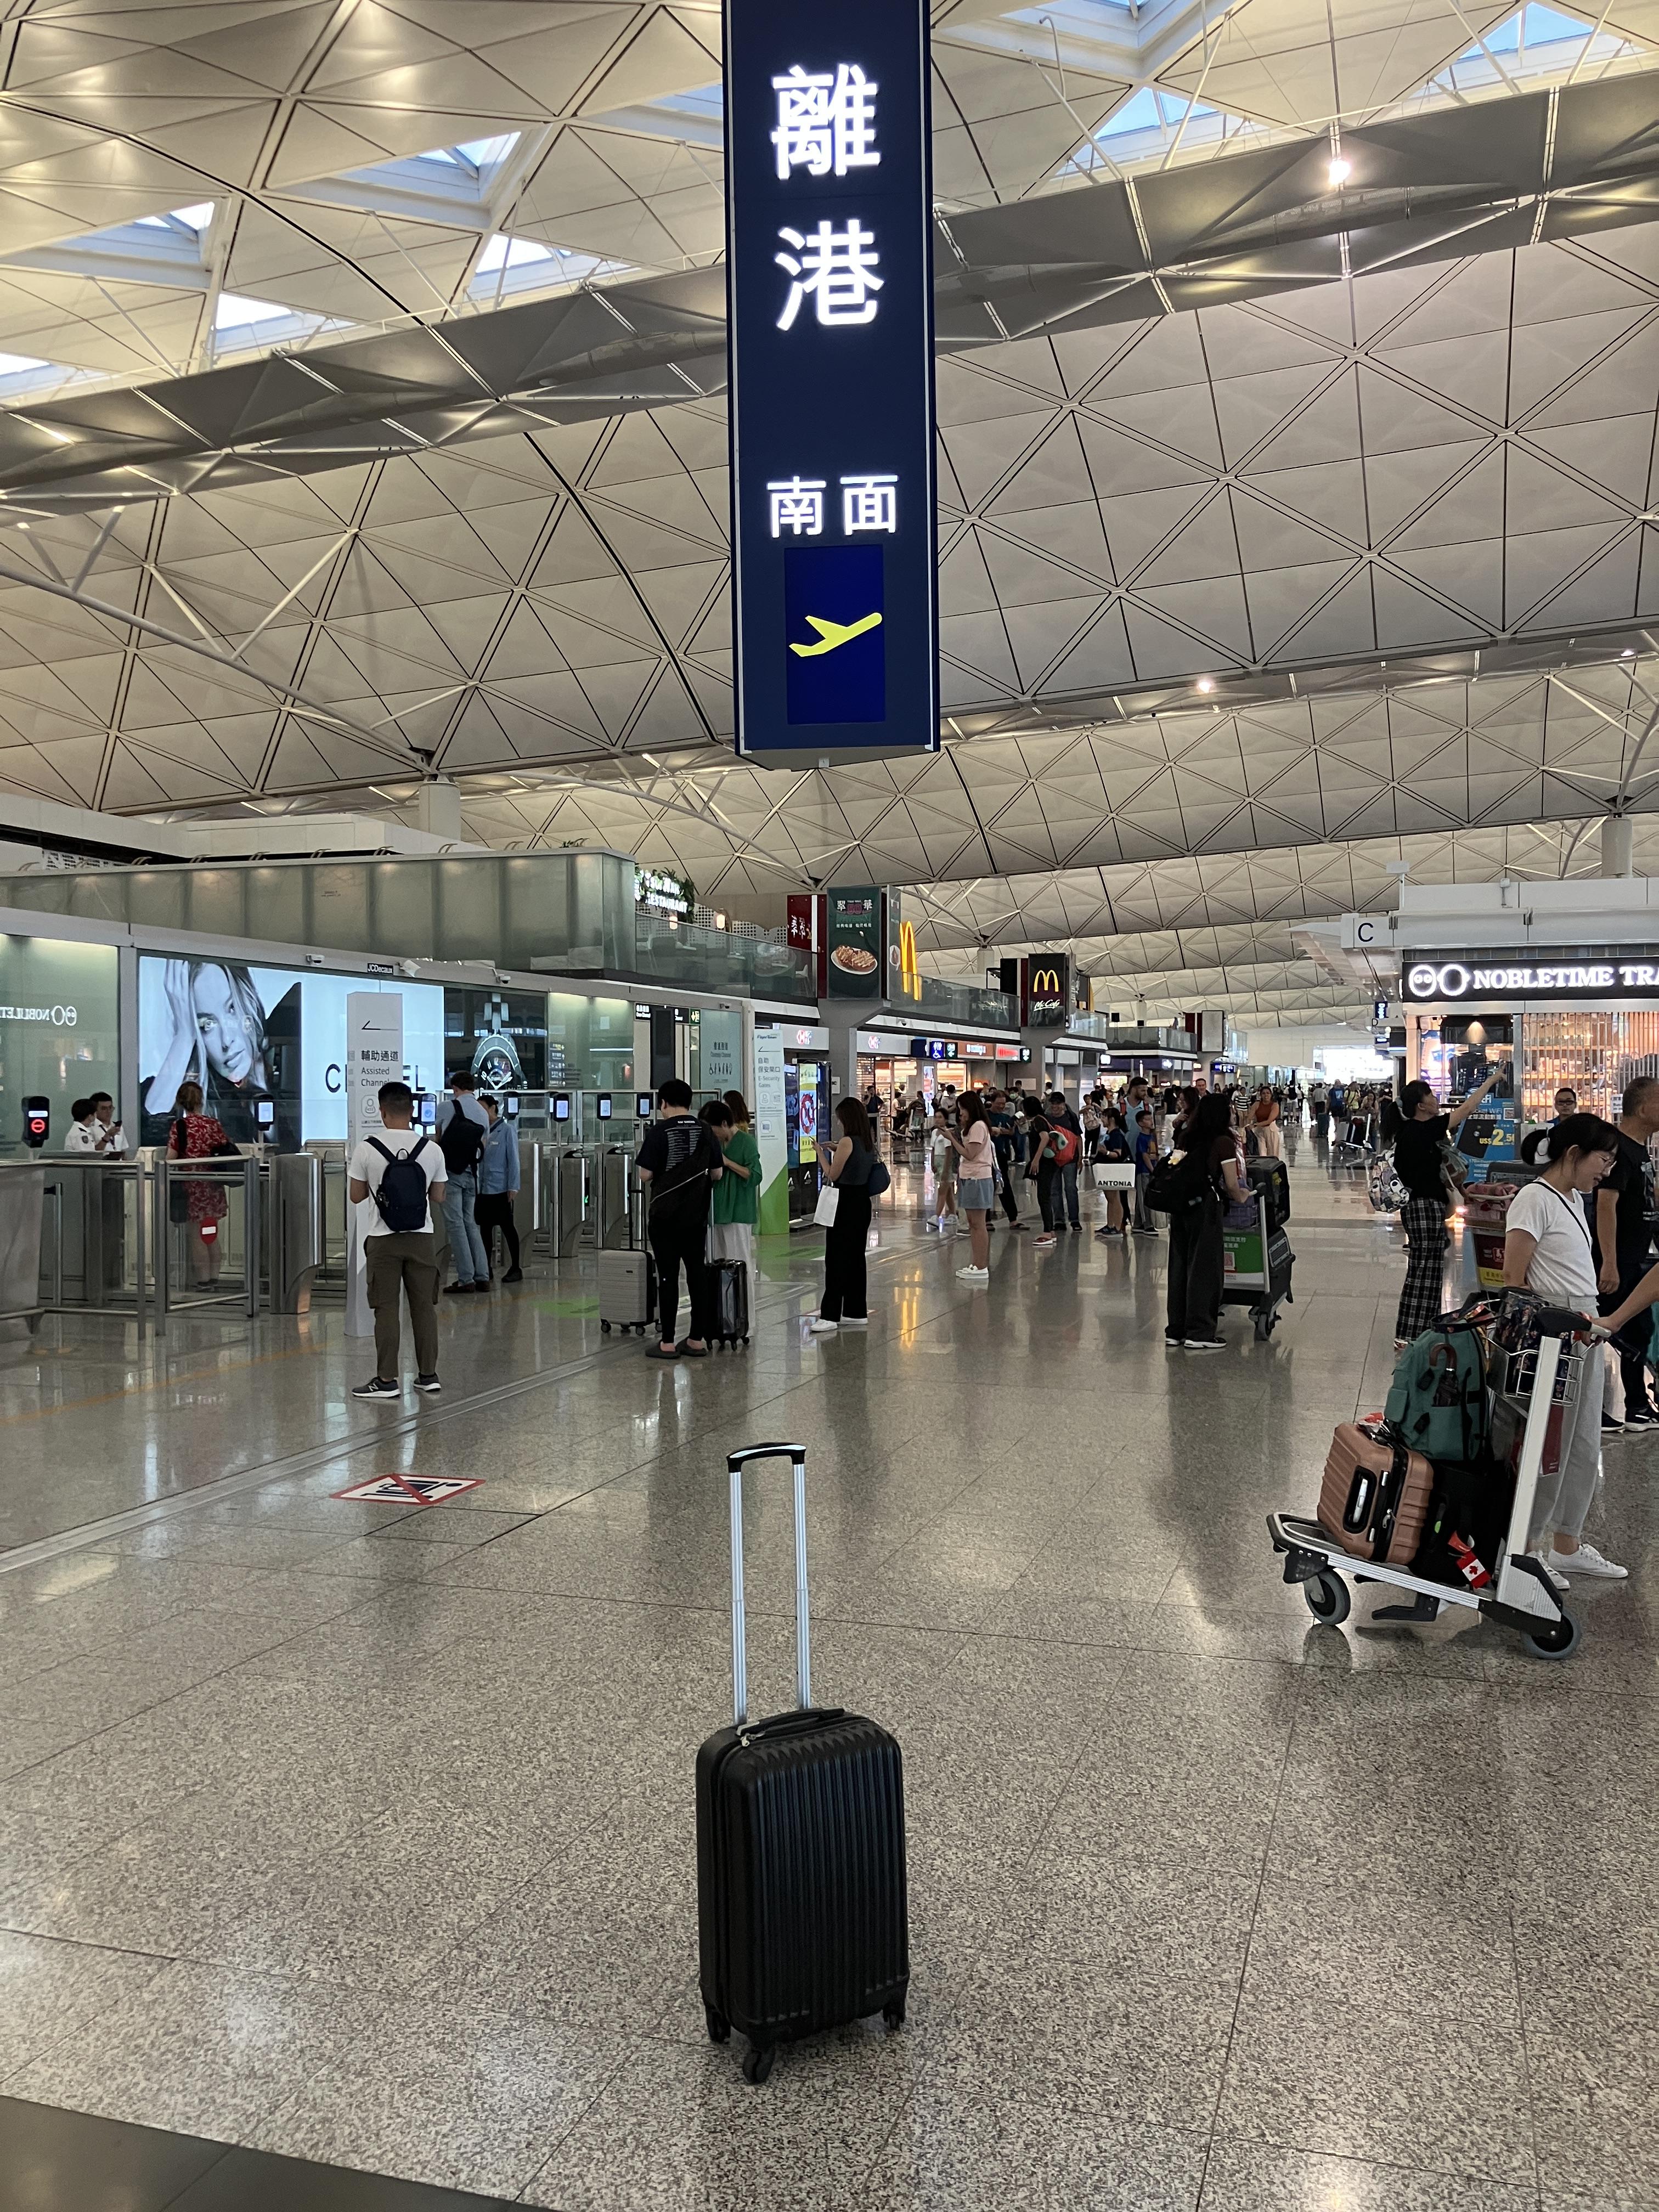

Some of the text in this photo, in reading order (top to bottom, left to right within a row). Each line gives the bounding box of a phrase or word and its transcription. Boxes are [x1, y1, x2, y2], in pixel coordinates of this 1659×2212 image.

[771, 63, 884, 331] 離港
[767, 475, 899, 538] 南面
[1358, 922, 1374, 943] C
[1473, 967, 1615, 989] NOBLETIME
[361, 1050, 399, 1062] 輔助通道
